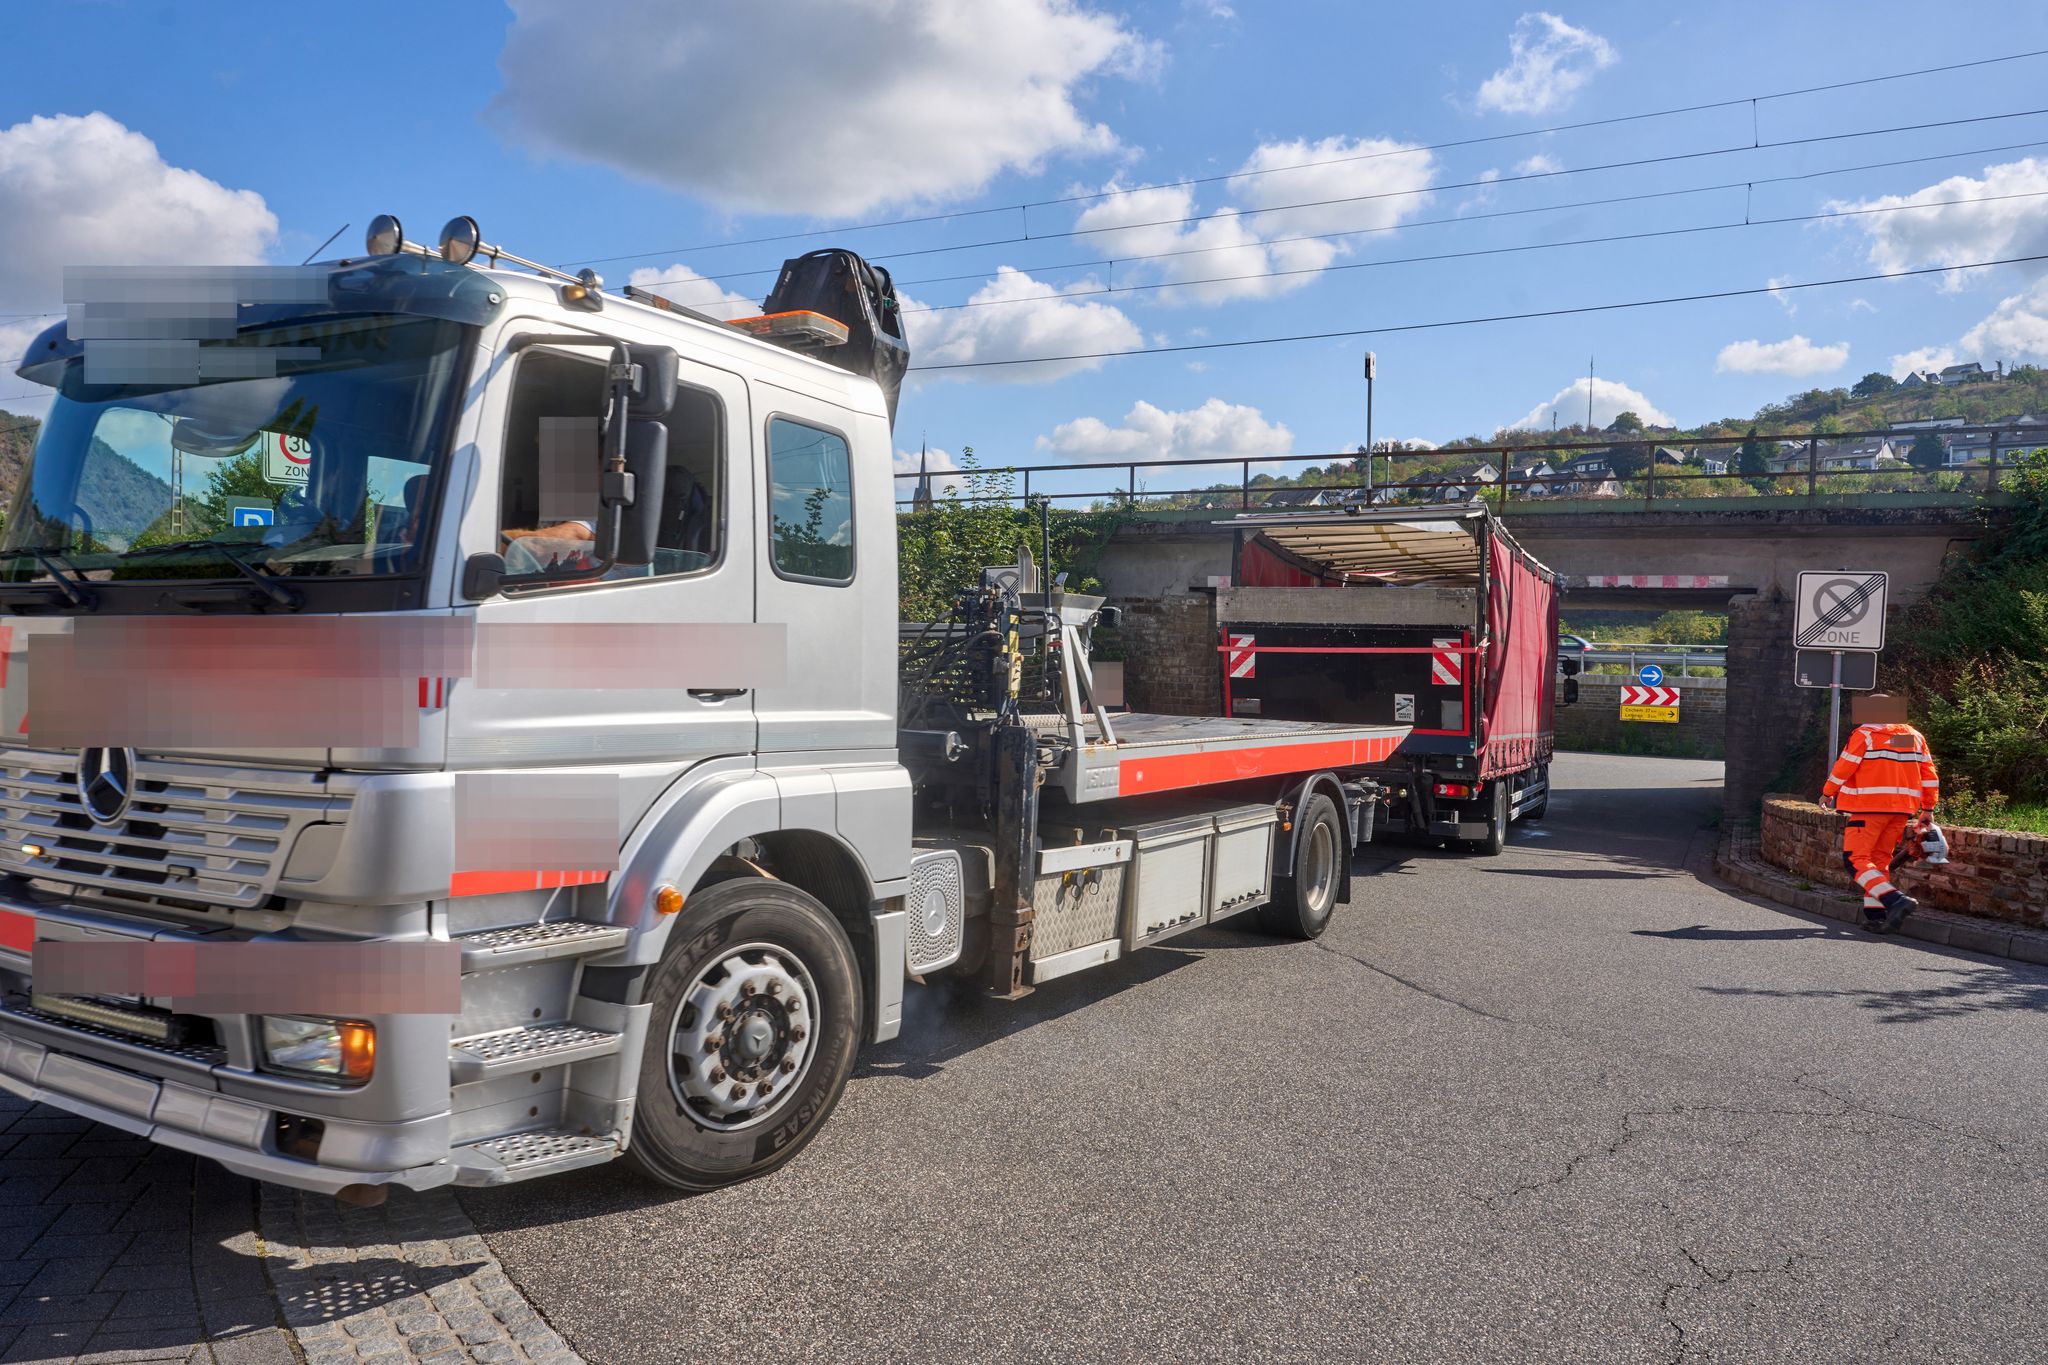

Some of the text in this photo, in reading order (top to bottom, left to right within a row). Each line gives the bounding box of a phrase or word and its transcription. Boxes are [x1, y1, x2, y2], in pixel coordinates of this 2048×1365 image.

[285, 466, 309, 477] ZON
[1818, 631, 1861, 643] ZONE
[773, 1087, 827, 1149] WSA2
